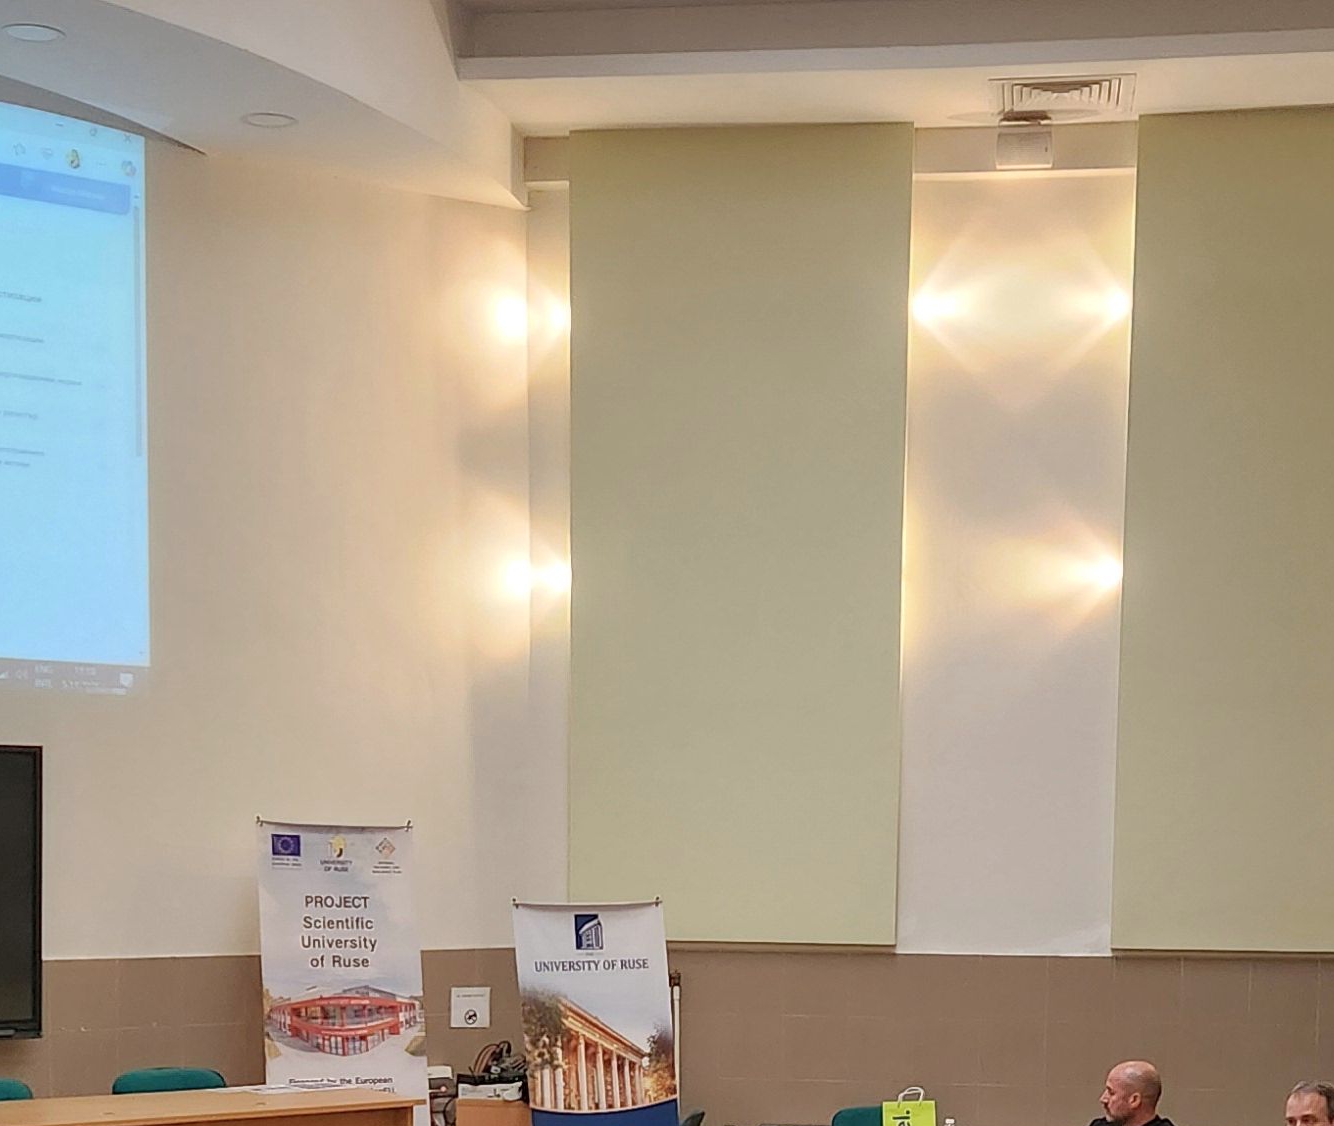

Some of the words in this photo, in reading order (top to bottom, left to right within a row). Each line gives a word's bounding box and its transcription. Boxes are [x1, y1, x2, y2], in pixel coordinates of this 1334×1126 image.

[304, 895, 371, 910] PROJECT
[302, 915, 375, 931] Scientific
[300, 935, 378, 954] University
[309, 955, 325, 969] of
[331, 956, 371, 969] Ruse
[534, 959, 601, 974] UNIVERSITY
[602, 959, 618, 972] OF
[619, 957, 650, 971] RUSE
[339, 1077, 354, 1086] the
[354, 1076, 394, 1087] European
